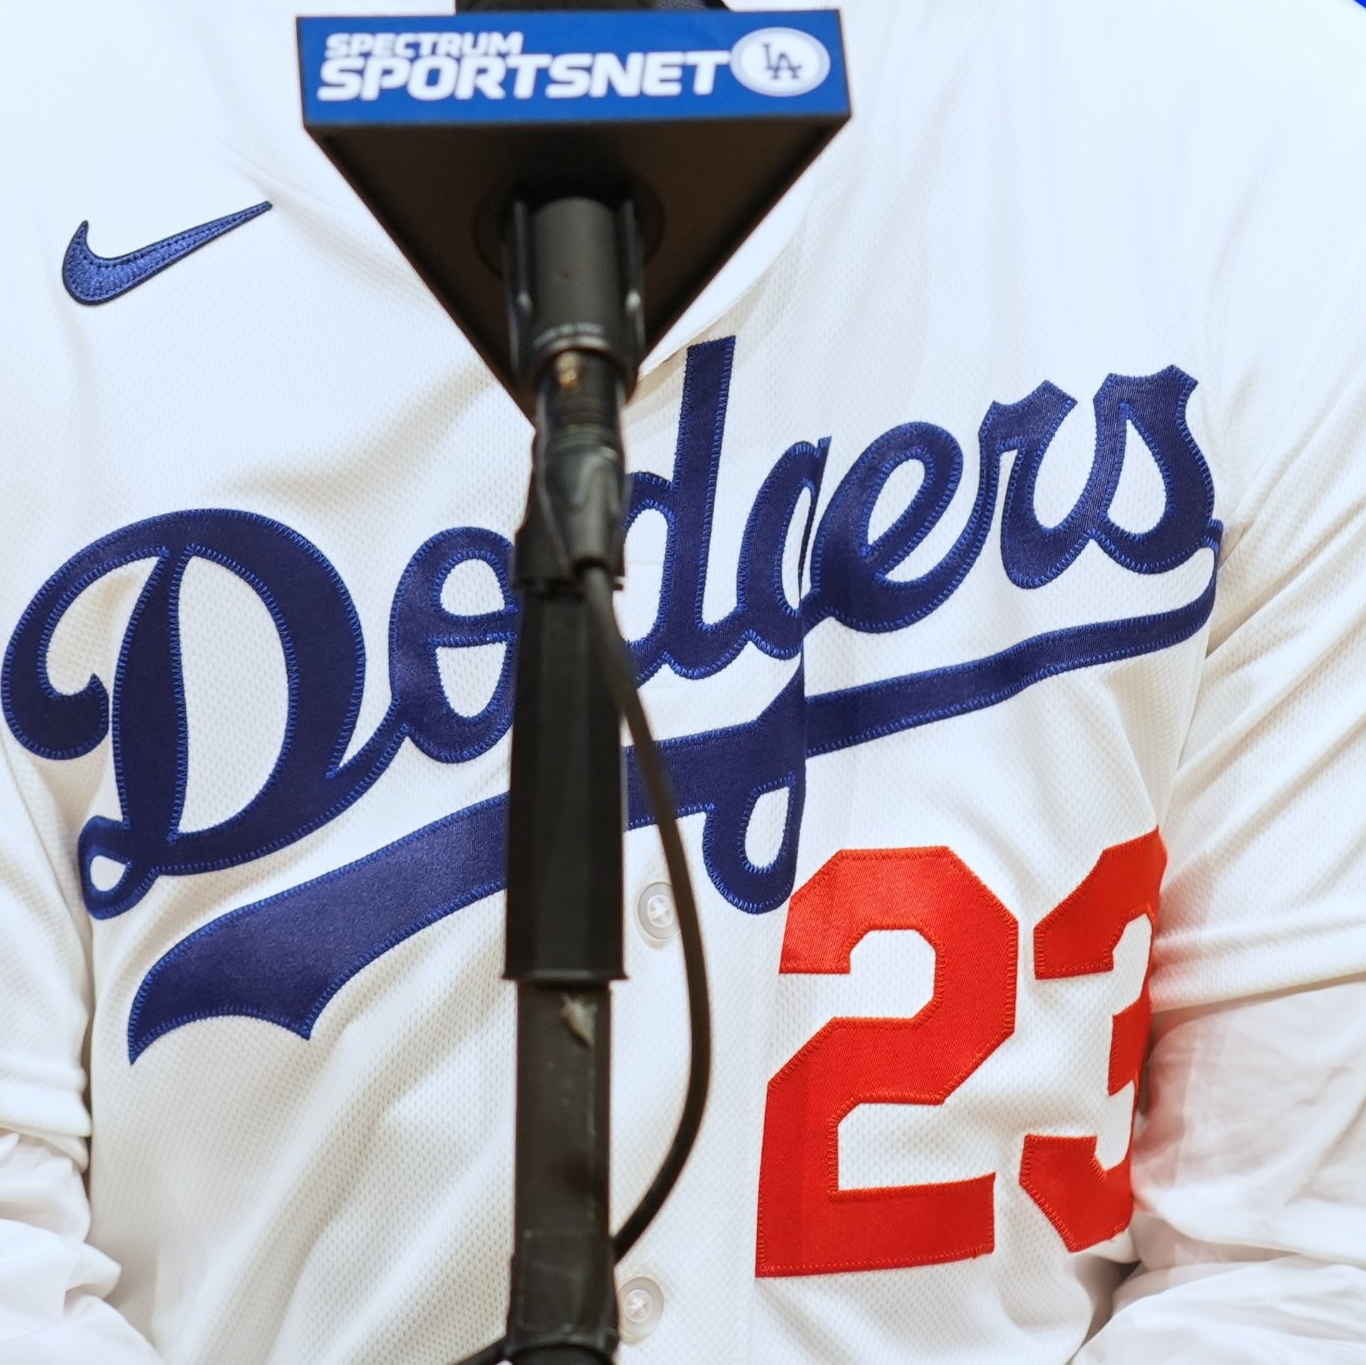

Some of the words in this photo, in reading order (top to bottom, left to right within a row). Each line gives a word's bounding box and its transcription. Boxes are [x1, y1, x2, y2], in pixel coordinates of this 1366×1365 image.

[325, 32, 524, 59] SPECTRUM
[762, 43, 802, 80] LA
[317, 50, 731, 101] SPORTSNET
[1, 336, 1222, 920] Dodgers
[755, 825, 1168, 1278] 23
